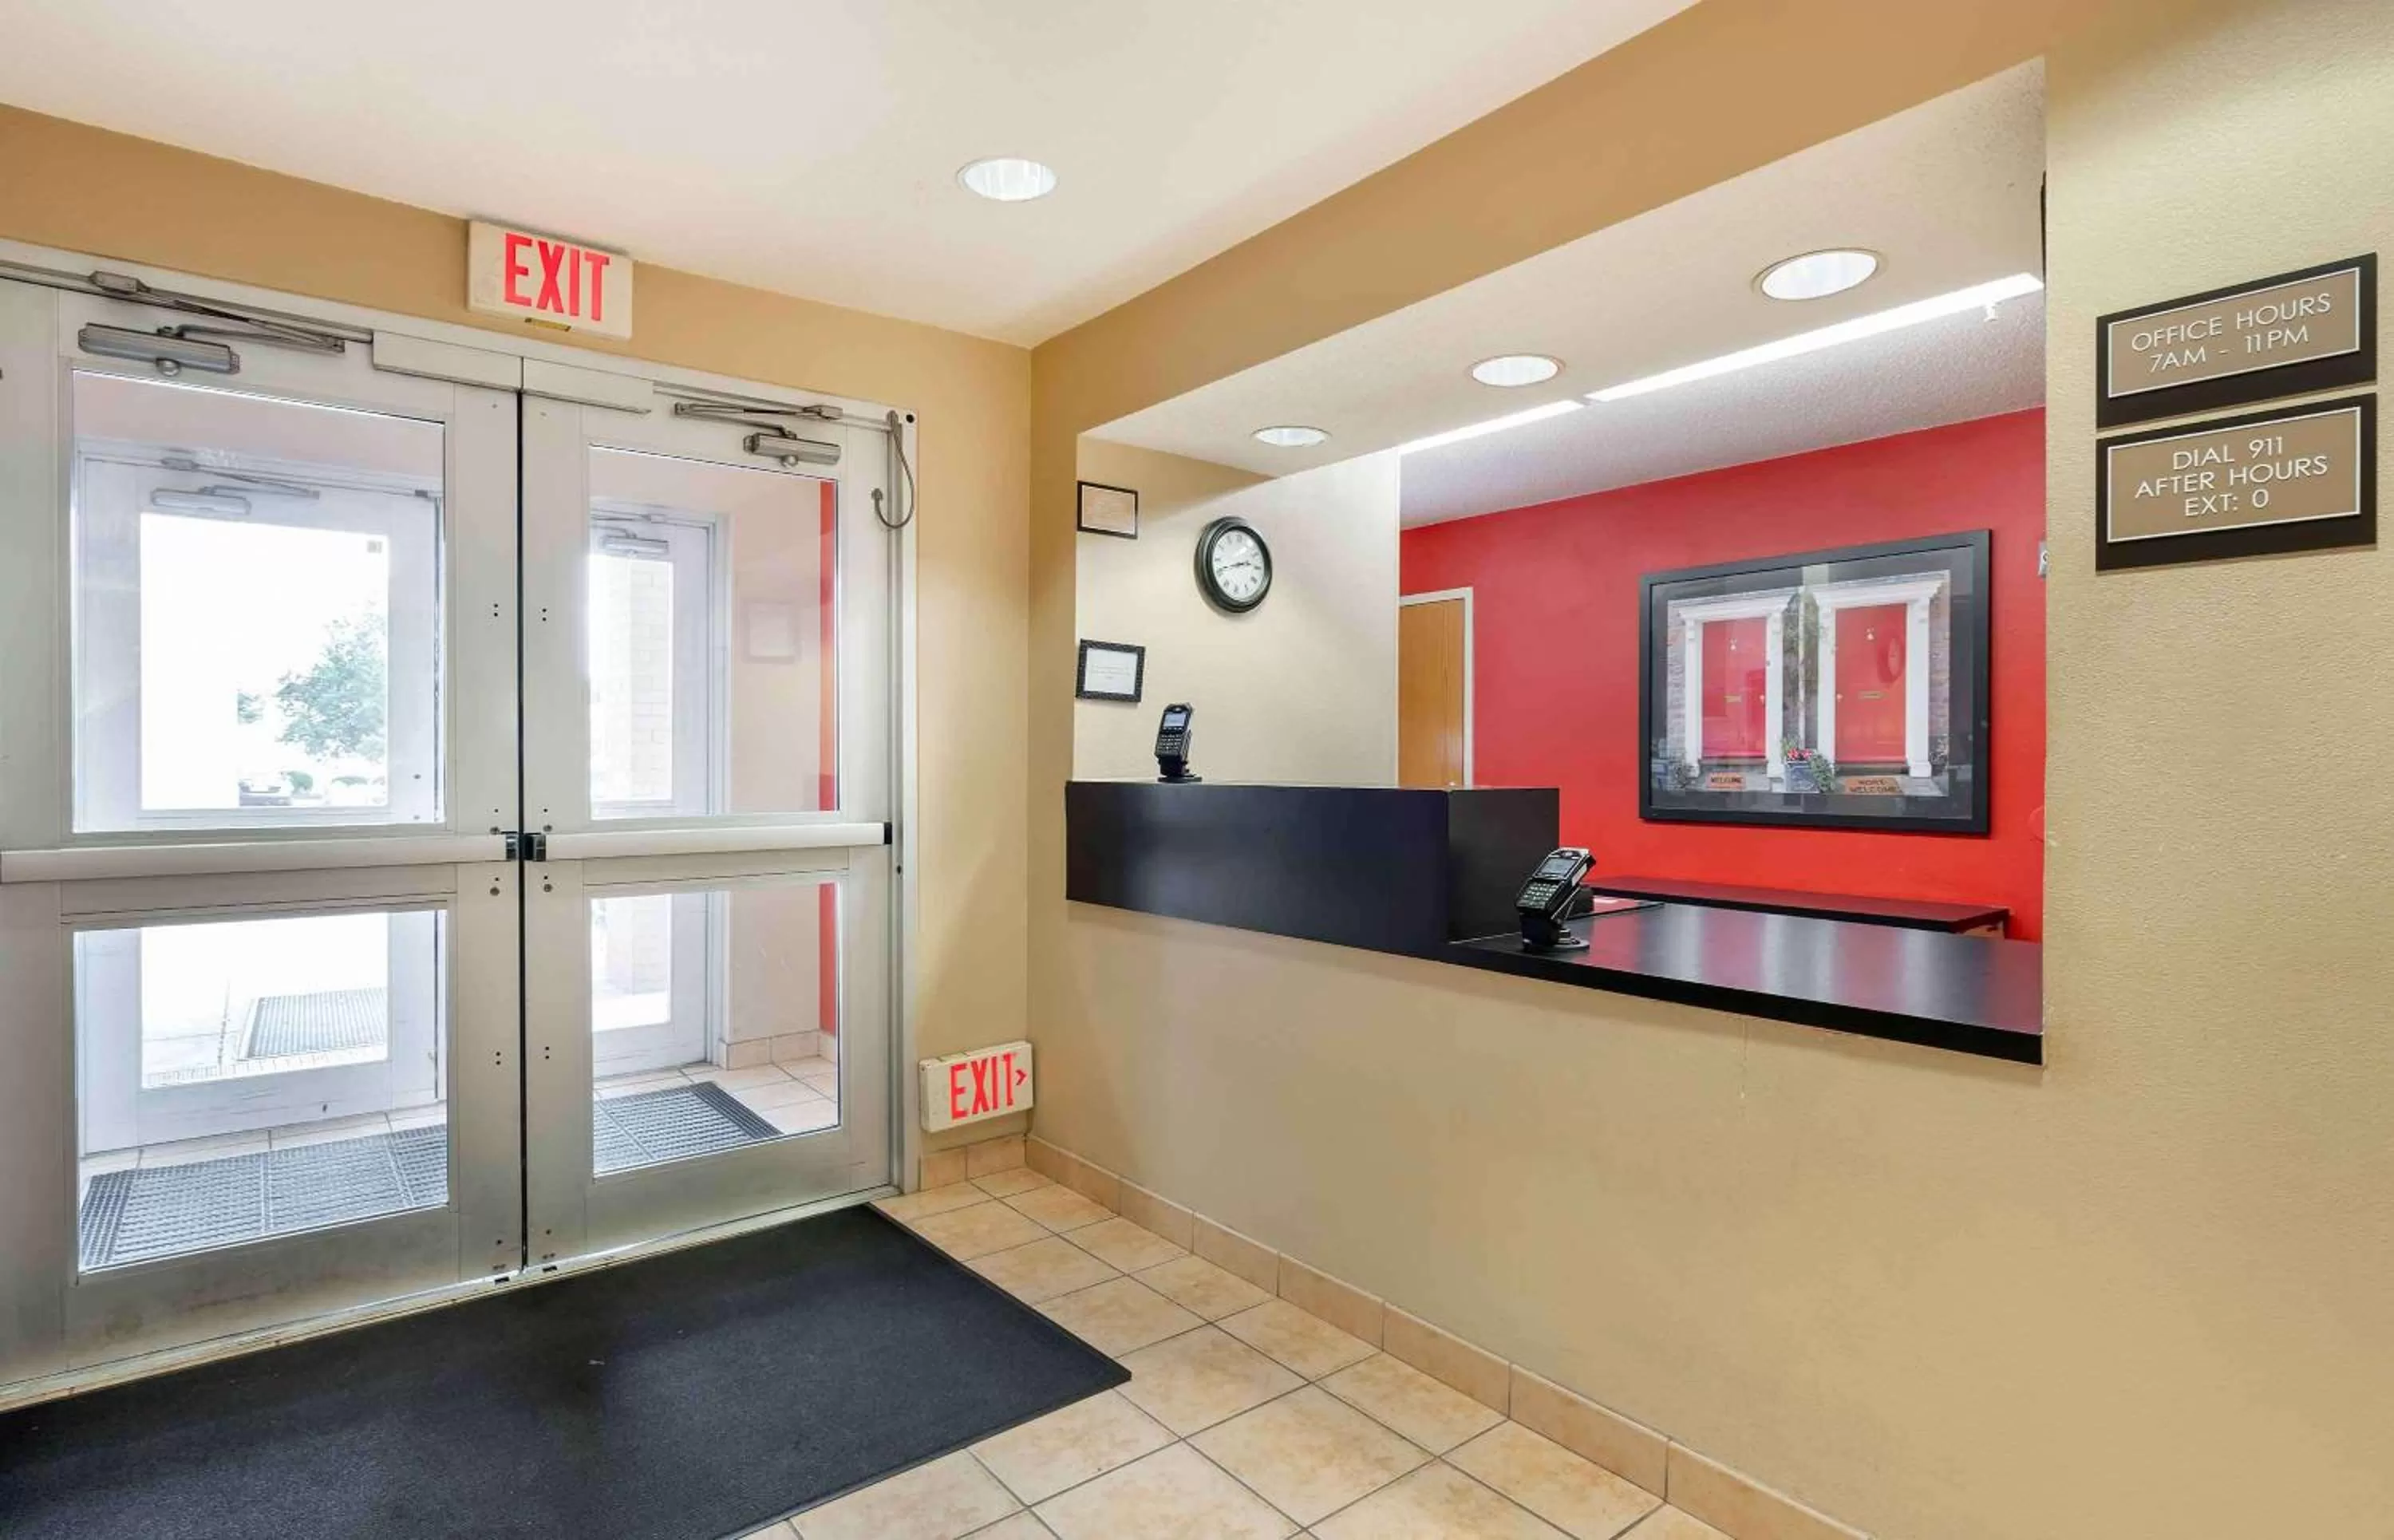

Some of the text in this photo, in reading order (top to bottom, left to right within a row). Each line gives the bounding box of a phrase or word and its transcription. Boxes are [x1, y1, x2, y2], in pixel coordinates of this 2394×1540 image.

[504, 232, 610, 322] EXIT
[2131, 293, 2332, 352] OFFICE HOURS
[2149, 346, 2207, 373] 7AM
[2172, 436, 2283, 471] DIAL 911
[2134, 456, 2329, 499] AFTER HOURS
[2184, 493, 2239, 517] EXT:
[950, 1052, 1017, 1120] EXIT
